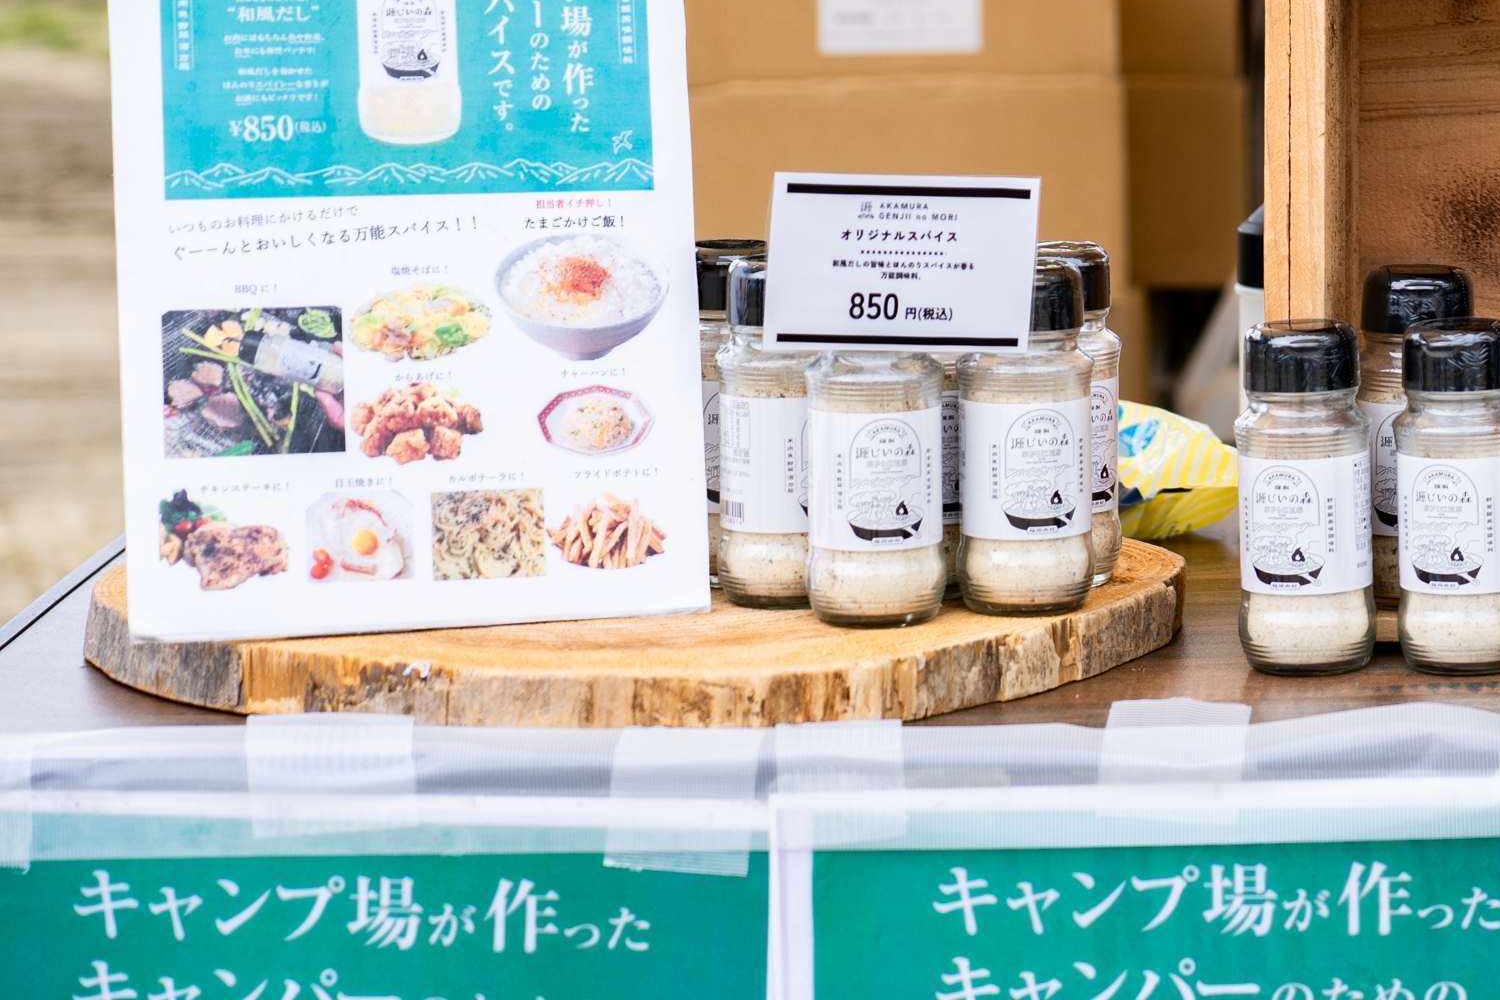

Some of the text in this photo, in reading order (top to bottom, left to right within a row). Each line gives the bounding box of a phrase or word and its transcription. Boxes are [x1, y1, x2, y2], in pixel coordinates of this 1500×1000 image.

[880, 202, 929, 210] AKAMURA
[168, 205, 359, 234] いつものお料理にかけるだけで
[524, 214, 625, 230] たまごかけご飯！
[931, 213, 958, 221] MORI
[841, 228, 958, 242] オリジナルスパイス
[849, 292, 953, 321] 850 円(税込)
[1010, 433, 1070, 448] 源じいの森
[855, 444, 916, 458] 源じいの森
[1255, 490, 1312, 504] 源じいの森
[1415, 489, 1472, 504] 源じいの森
[72, 869, 651, 953] キャンプ場が作った
